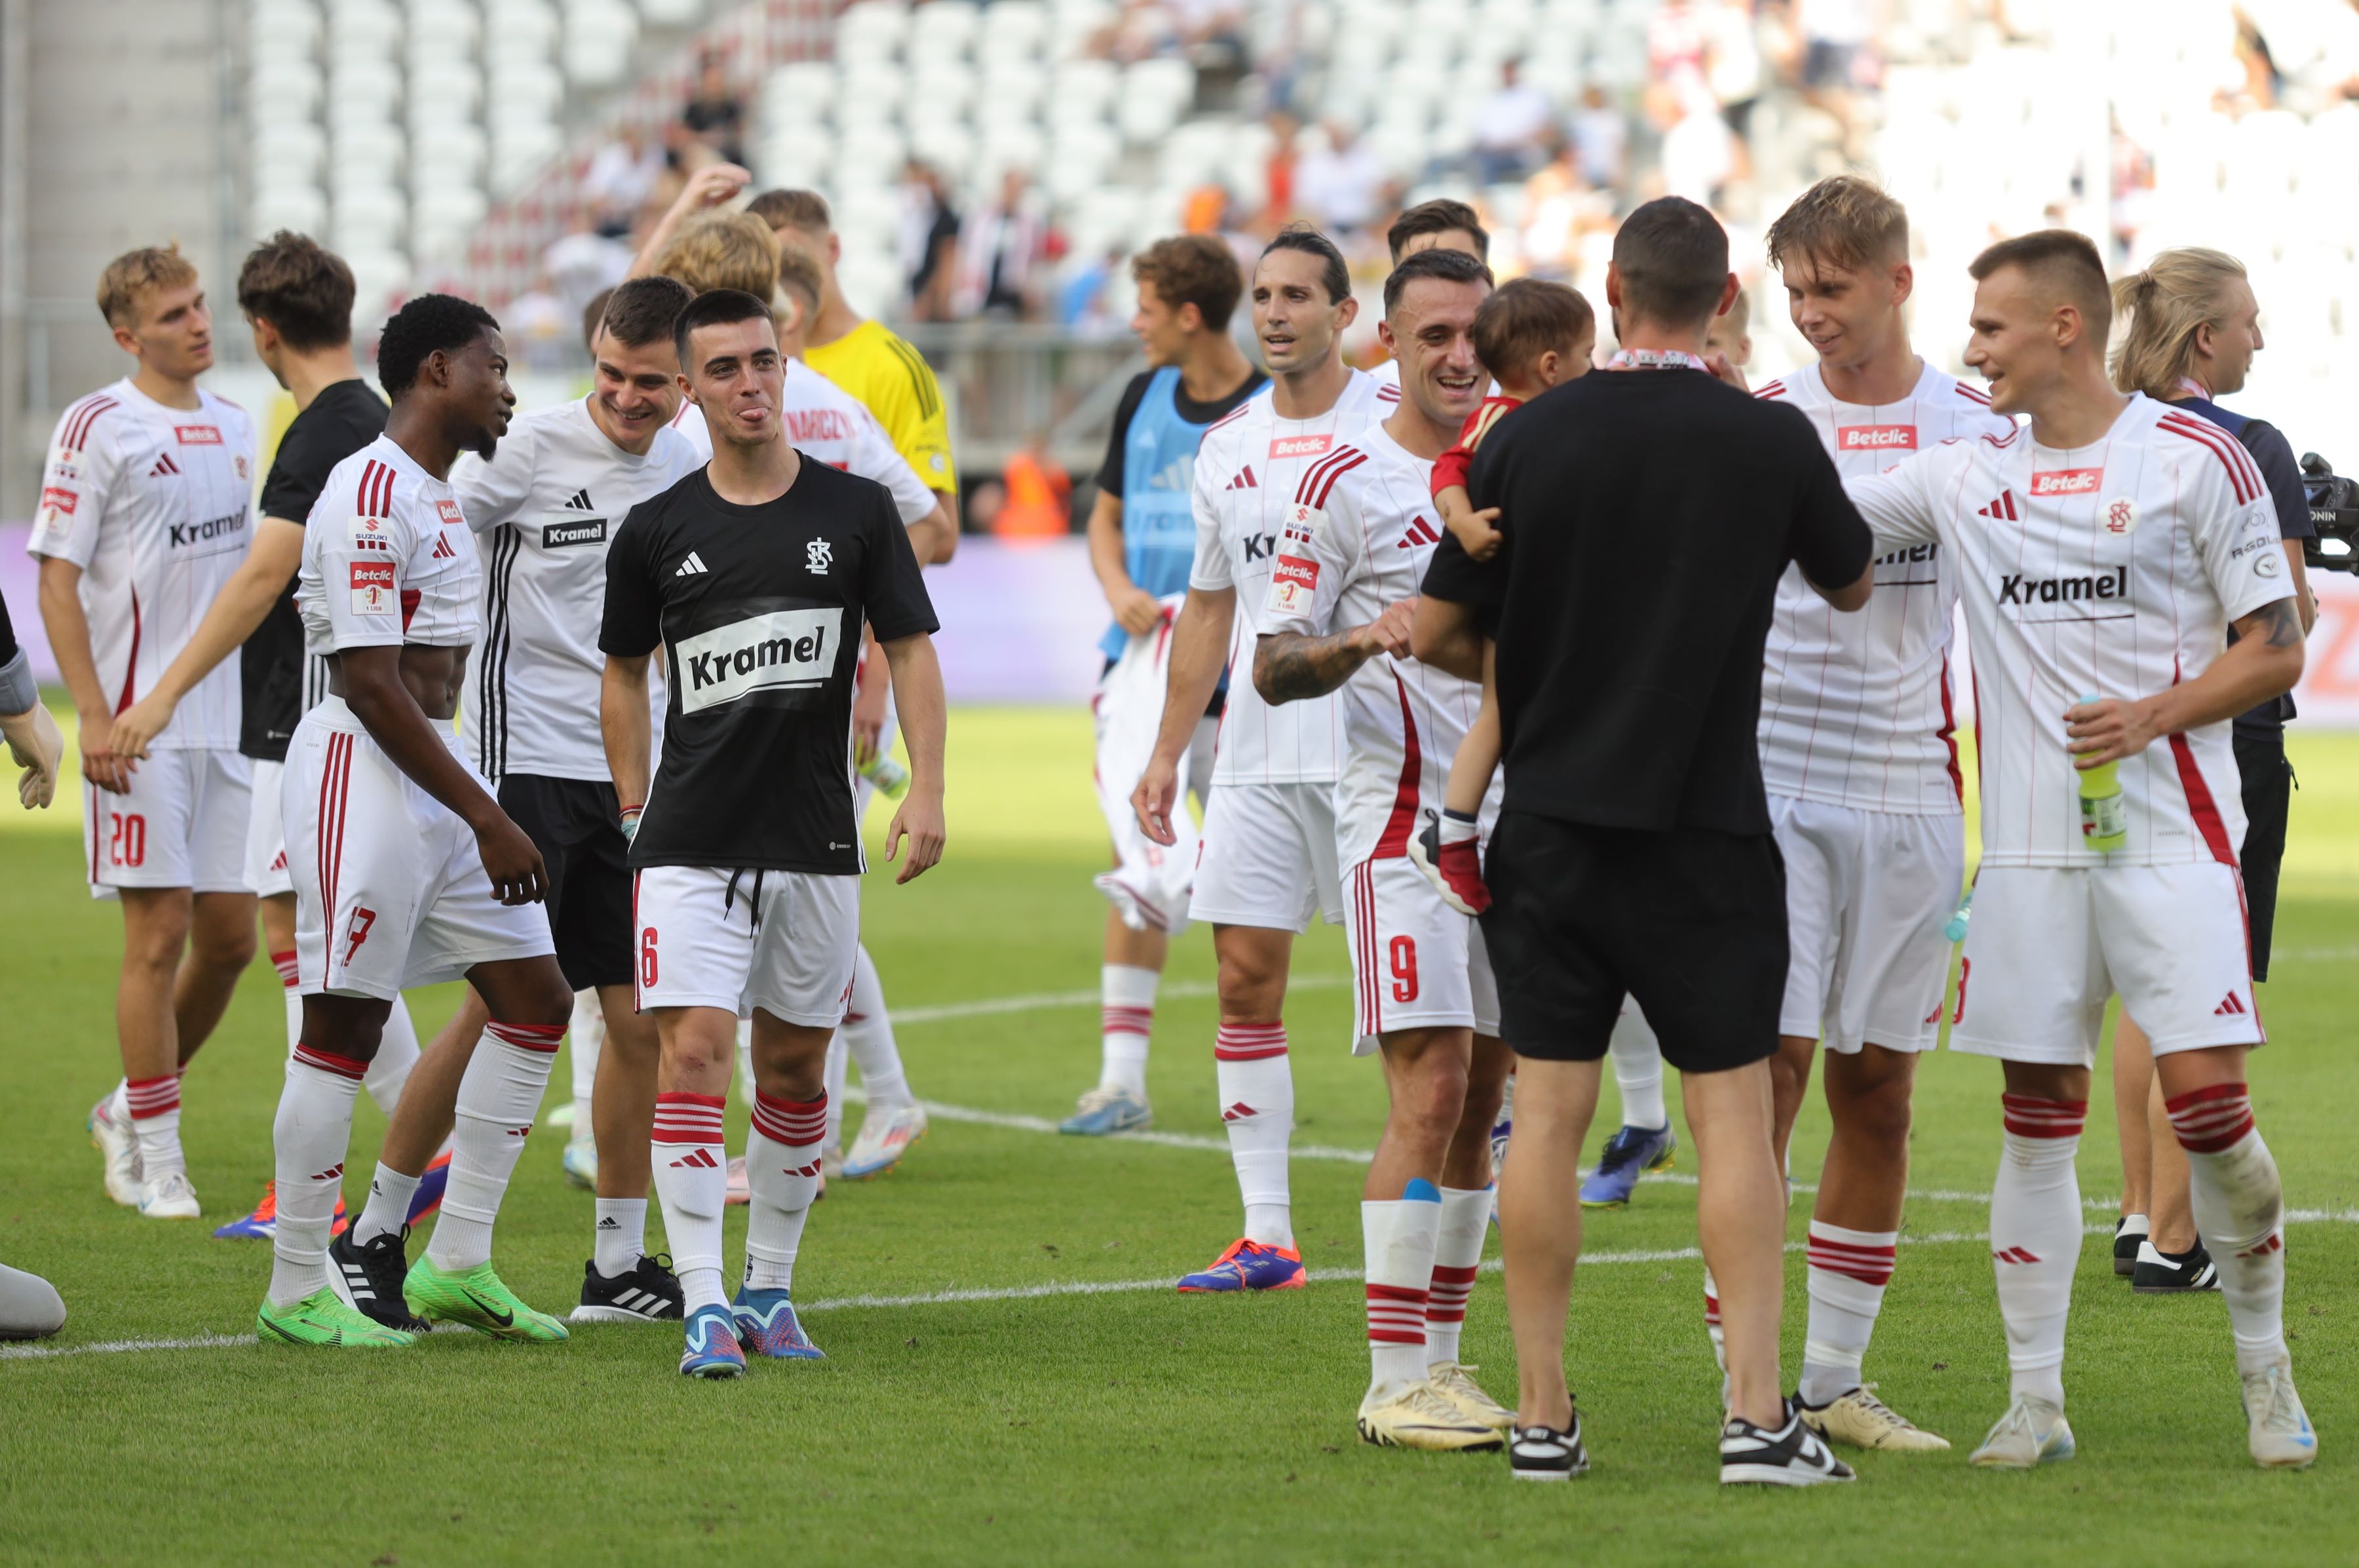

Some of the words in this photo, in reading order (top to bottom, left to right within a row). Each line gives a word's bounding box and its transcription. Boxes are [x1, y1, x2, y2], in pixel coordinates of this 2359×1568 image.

[1275, 437, 1326, 455] Betclic
[1846, 429, 1909, 446] Betclic
[2038, 472, 2096, 491] Betclic
[170, 505, 246, 548] Kramel
[549, 524, 602, 543] Kramel
[1286, 522, 1314, 535] SUZUKI
[354, 569, 391, 581] Betclic
[1276, 562, 1314, 581] Betclic
[1999, 565, 2128, 604] Kramel
[688, 626, 825, 691] Kramel
[111, 812, 145, 868] 20
[642, 927, 659, 988] 6
[1390, 935, 1418, 1003] 9
